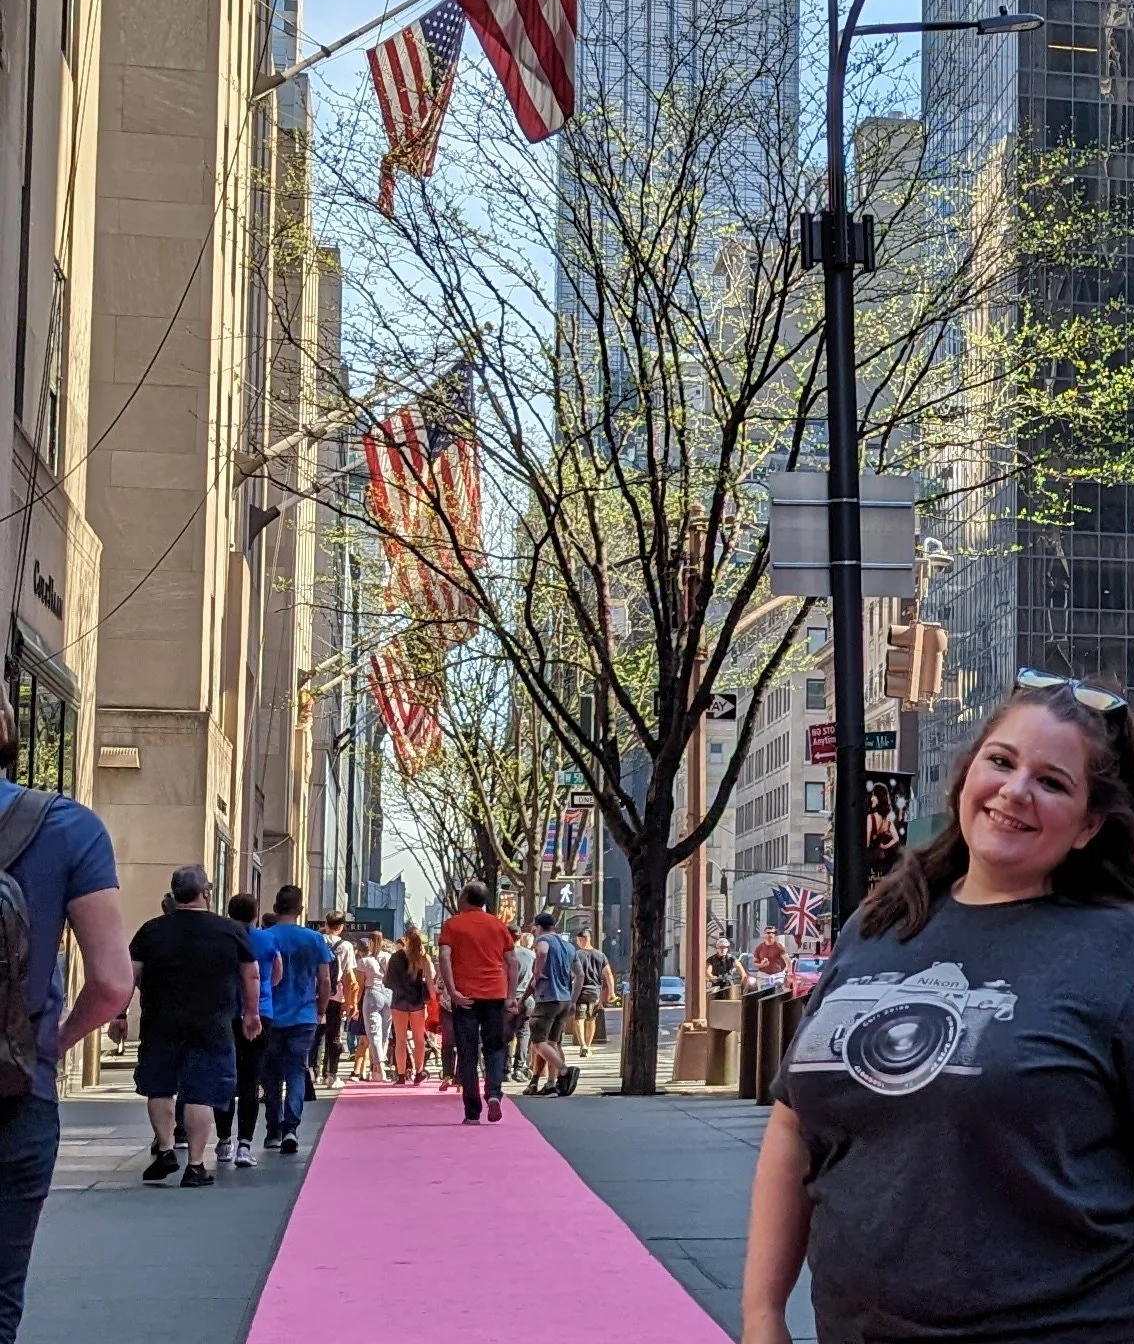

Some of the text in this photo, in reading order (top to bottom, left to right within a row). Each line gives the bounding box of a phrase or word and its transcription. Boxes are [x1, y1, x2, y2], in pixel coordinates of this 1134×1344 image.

[707, 701, 728, 712] AY
[811, 728, 821, 736] NO
[572, 772, 584, 784] 50
[916, 977, 960, 988] Nikon
